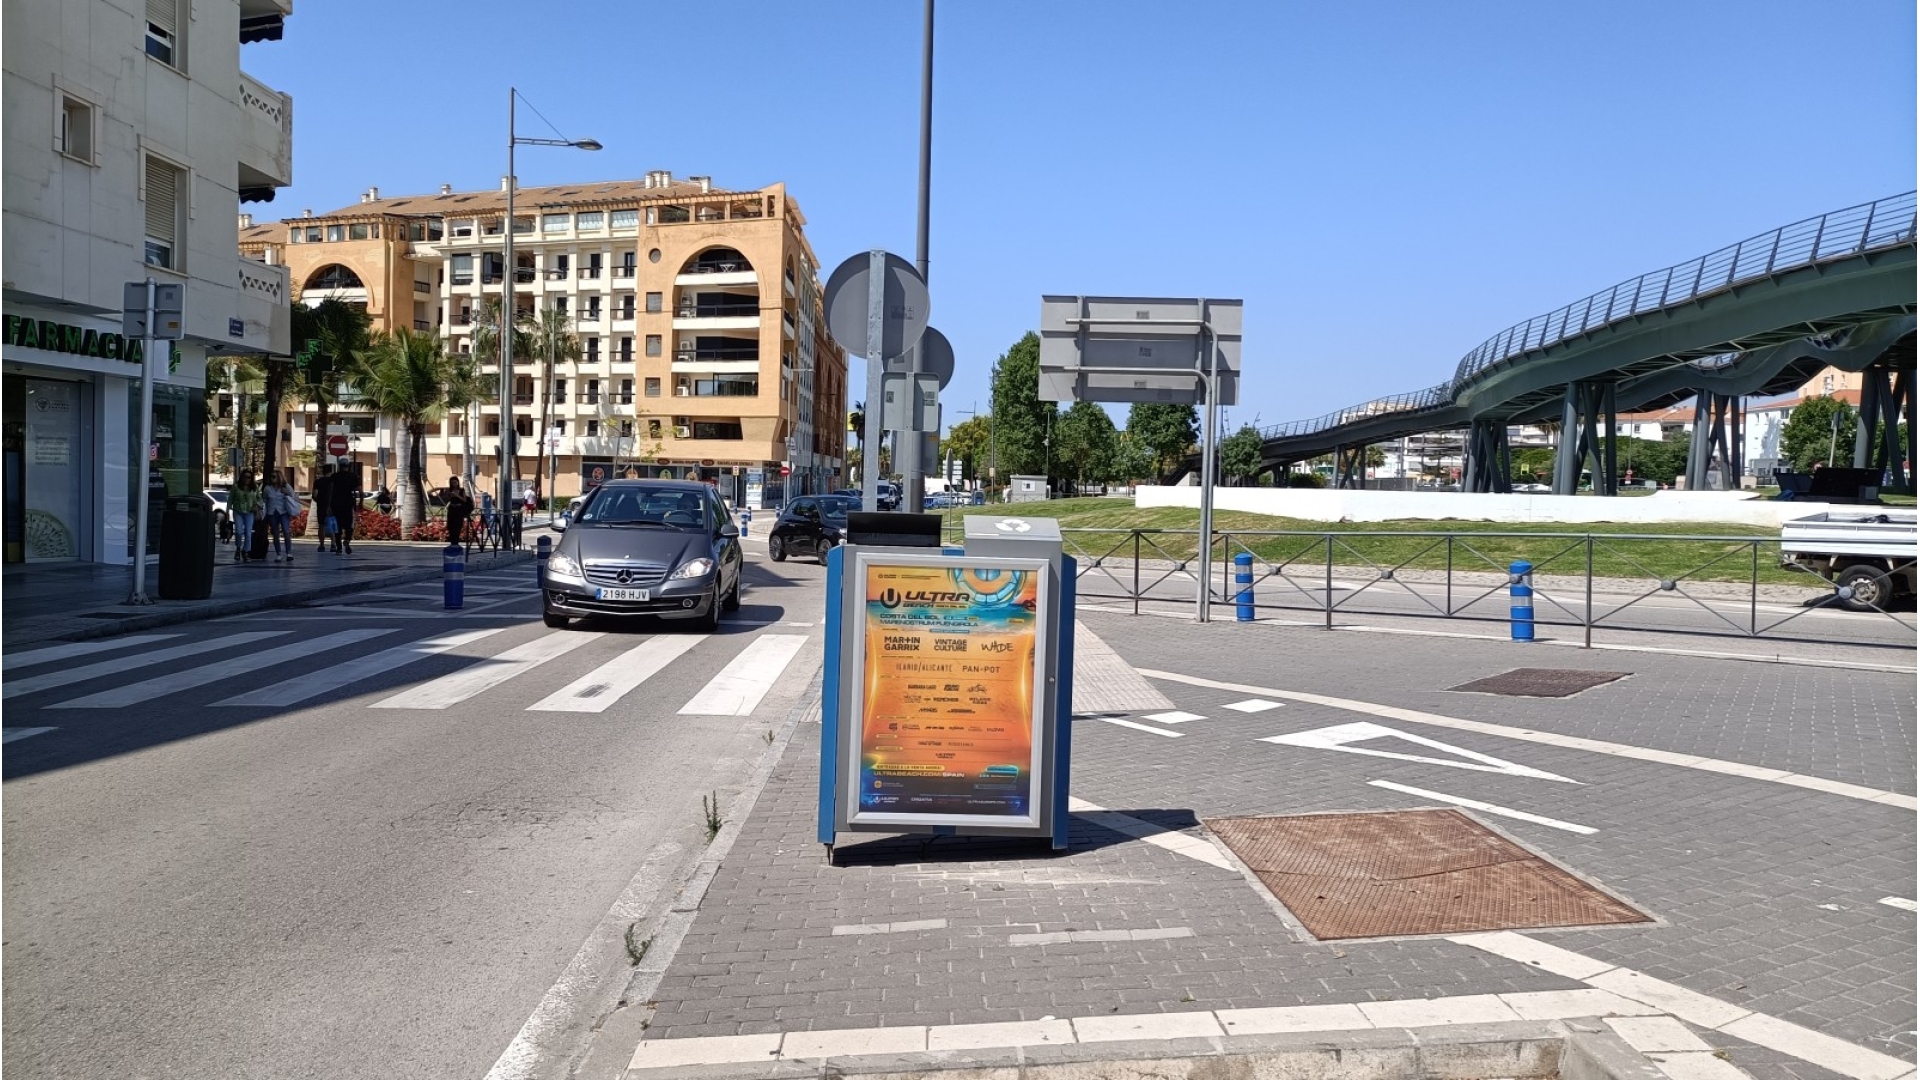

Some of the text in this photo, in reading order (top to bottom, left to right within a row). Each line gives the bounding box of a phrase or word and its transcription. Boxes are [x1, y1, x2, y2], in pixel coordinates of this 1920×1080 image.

[2, 314, 143, 364] FARMACIA
[602, 589, 647, 600] 2198 HJV
[904, 590, 971, 603] ULTRA
[884, 643, 920, 651] GARRIX
[933, 644, 968, 652] CULTURE
[962, 665, 1001, 674] PAN-POT
